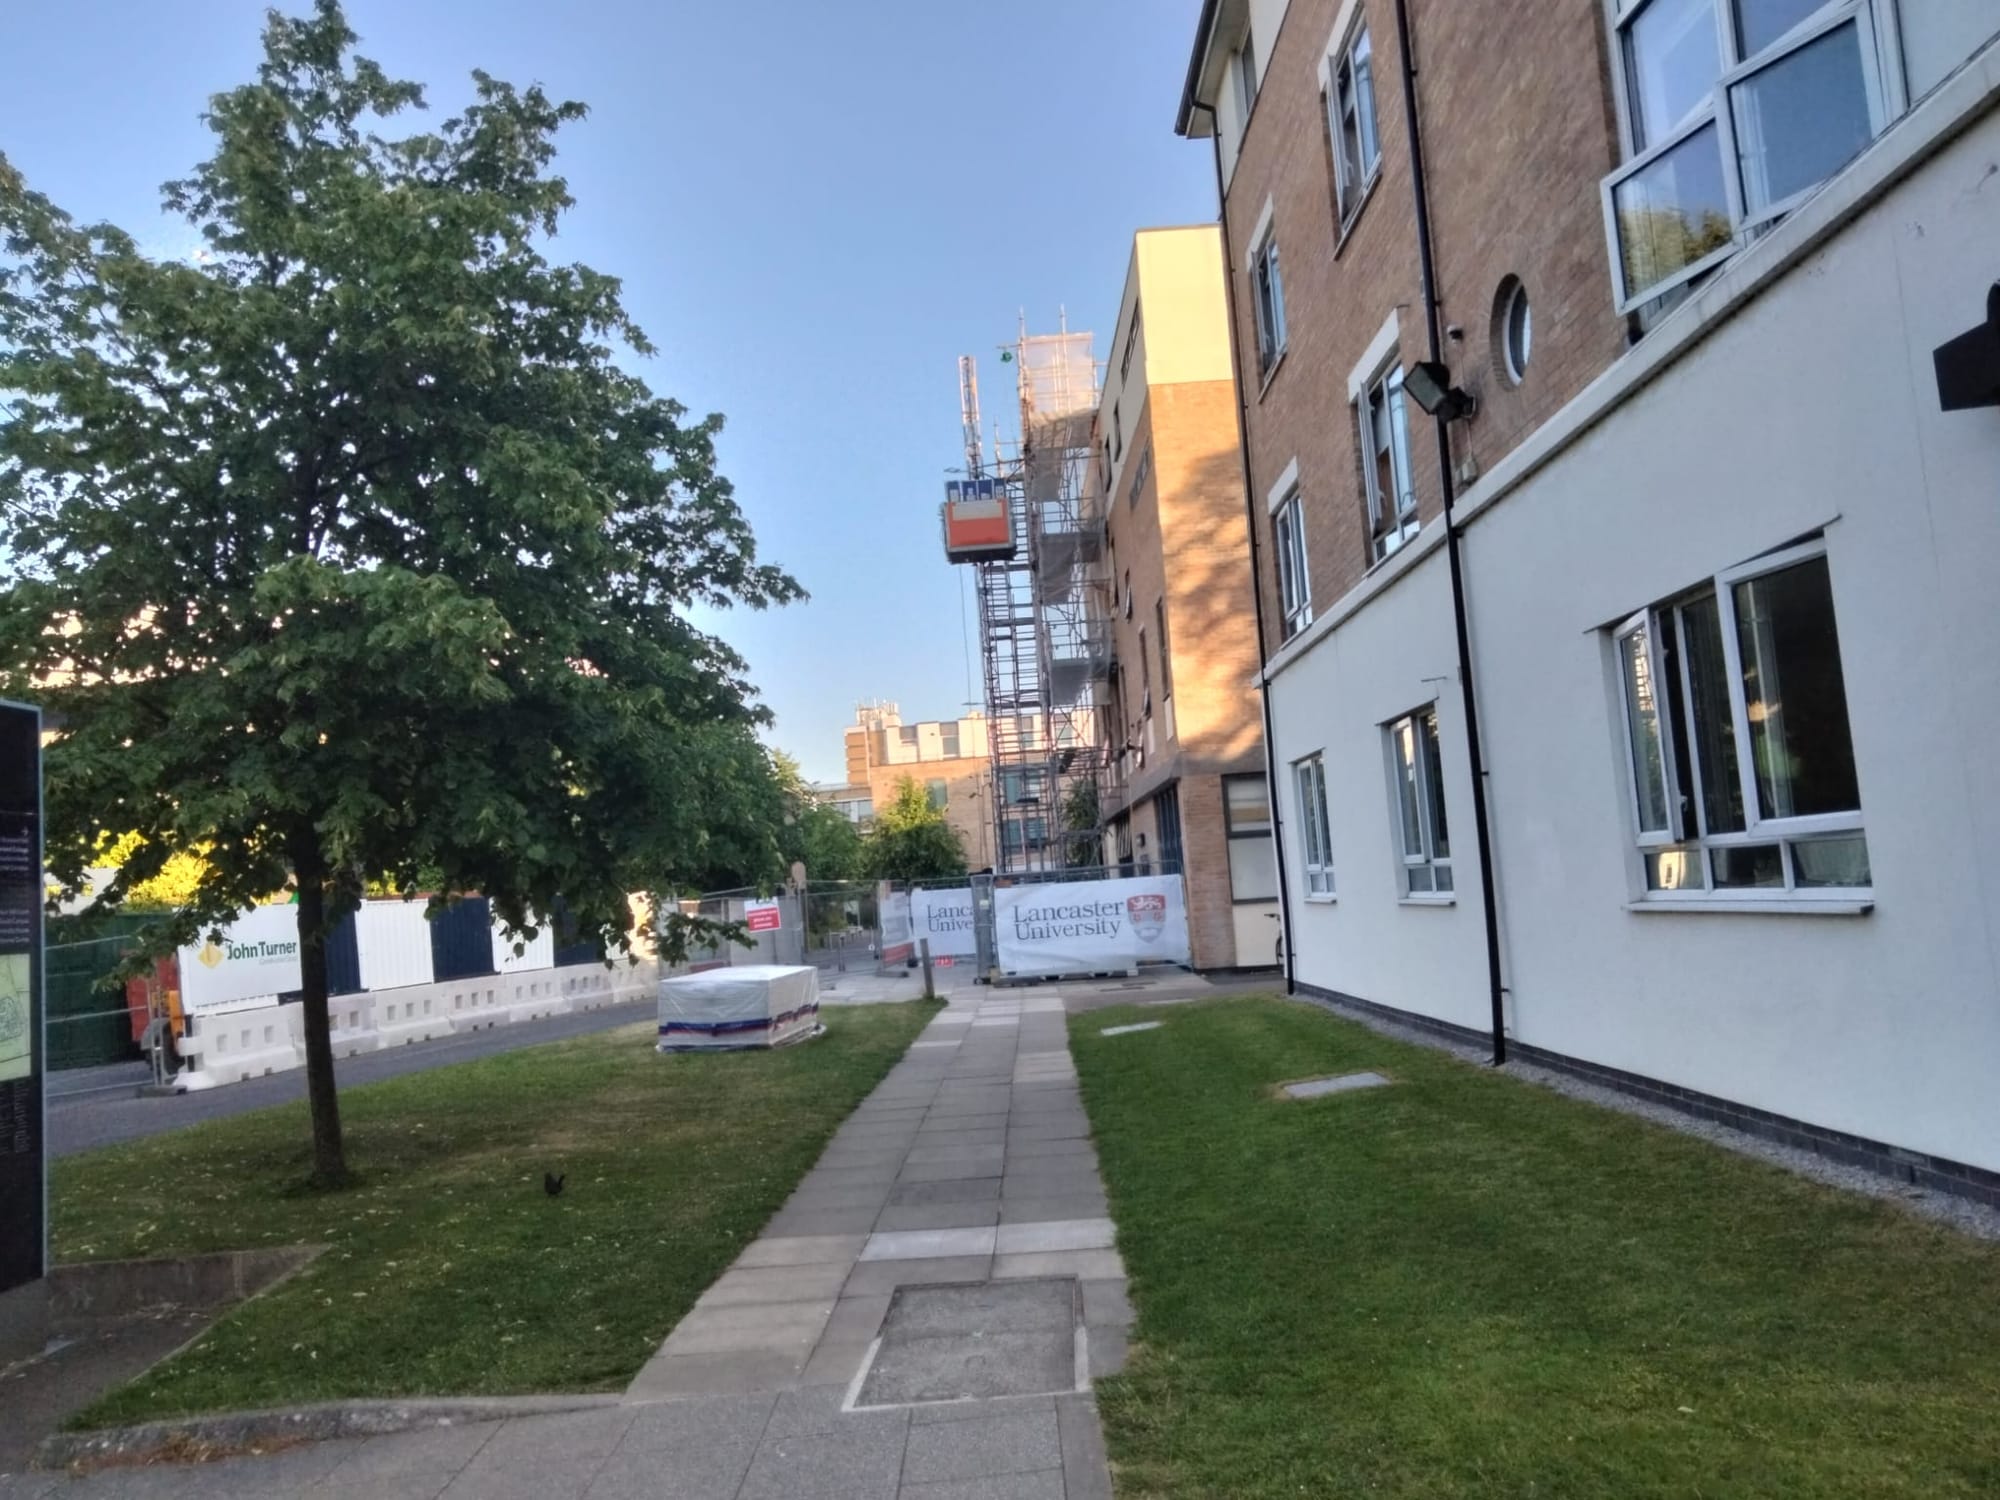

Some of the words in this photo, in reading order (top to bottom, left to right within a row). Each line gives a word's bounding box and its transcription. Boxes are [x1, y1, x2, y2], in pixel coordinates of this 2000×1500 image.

[1013, 900, 1124, 923] Lancaster
[1015, 918, 1121, 940] University
[227, 943, 258, 960] John
[258, 941, 297, 957] Turner
